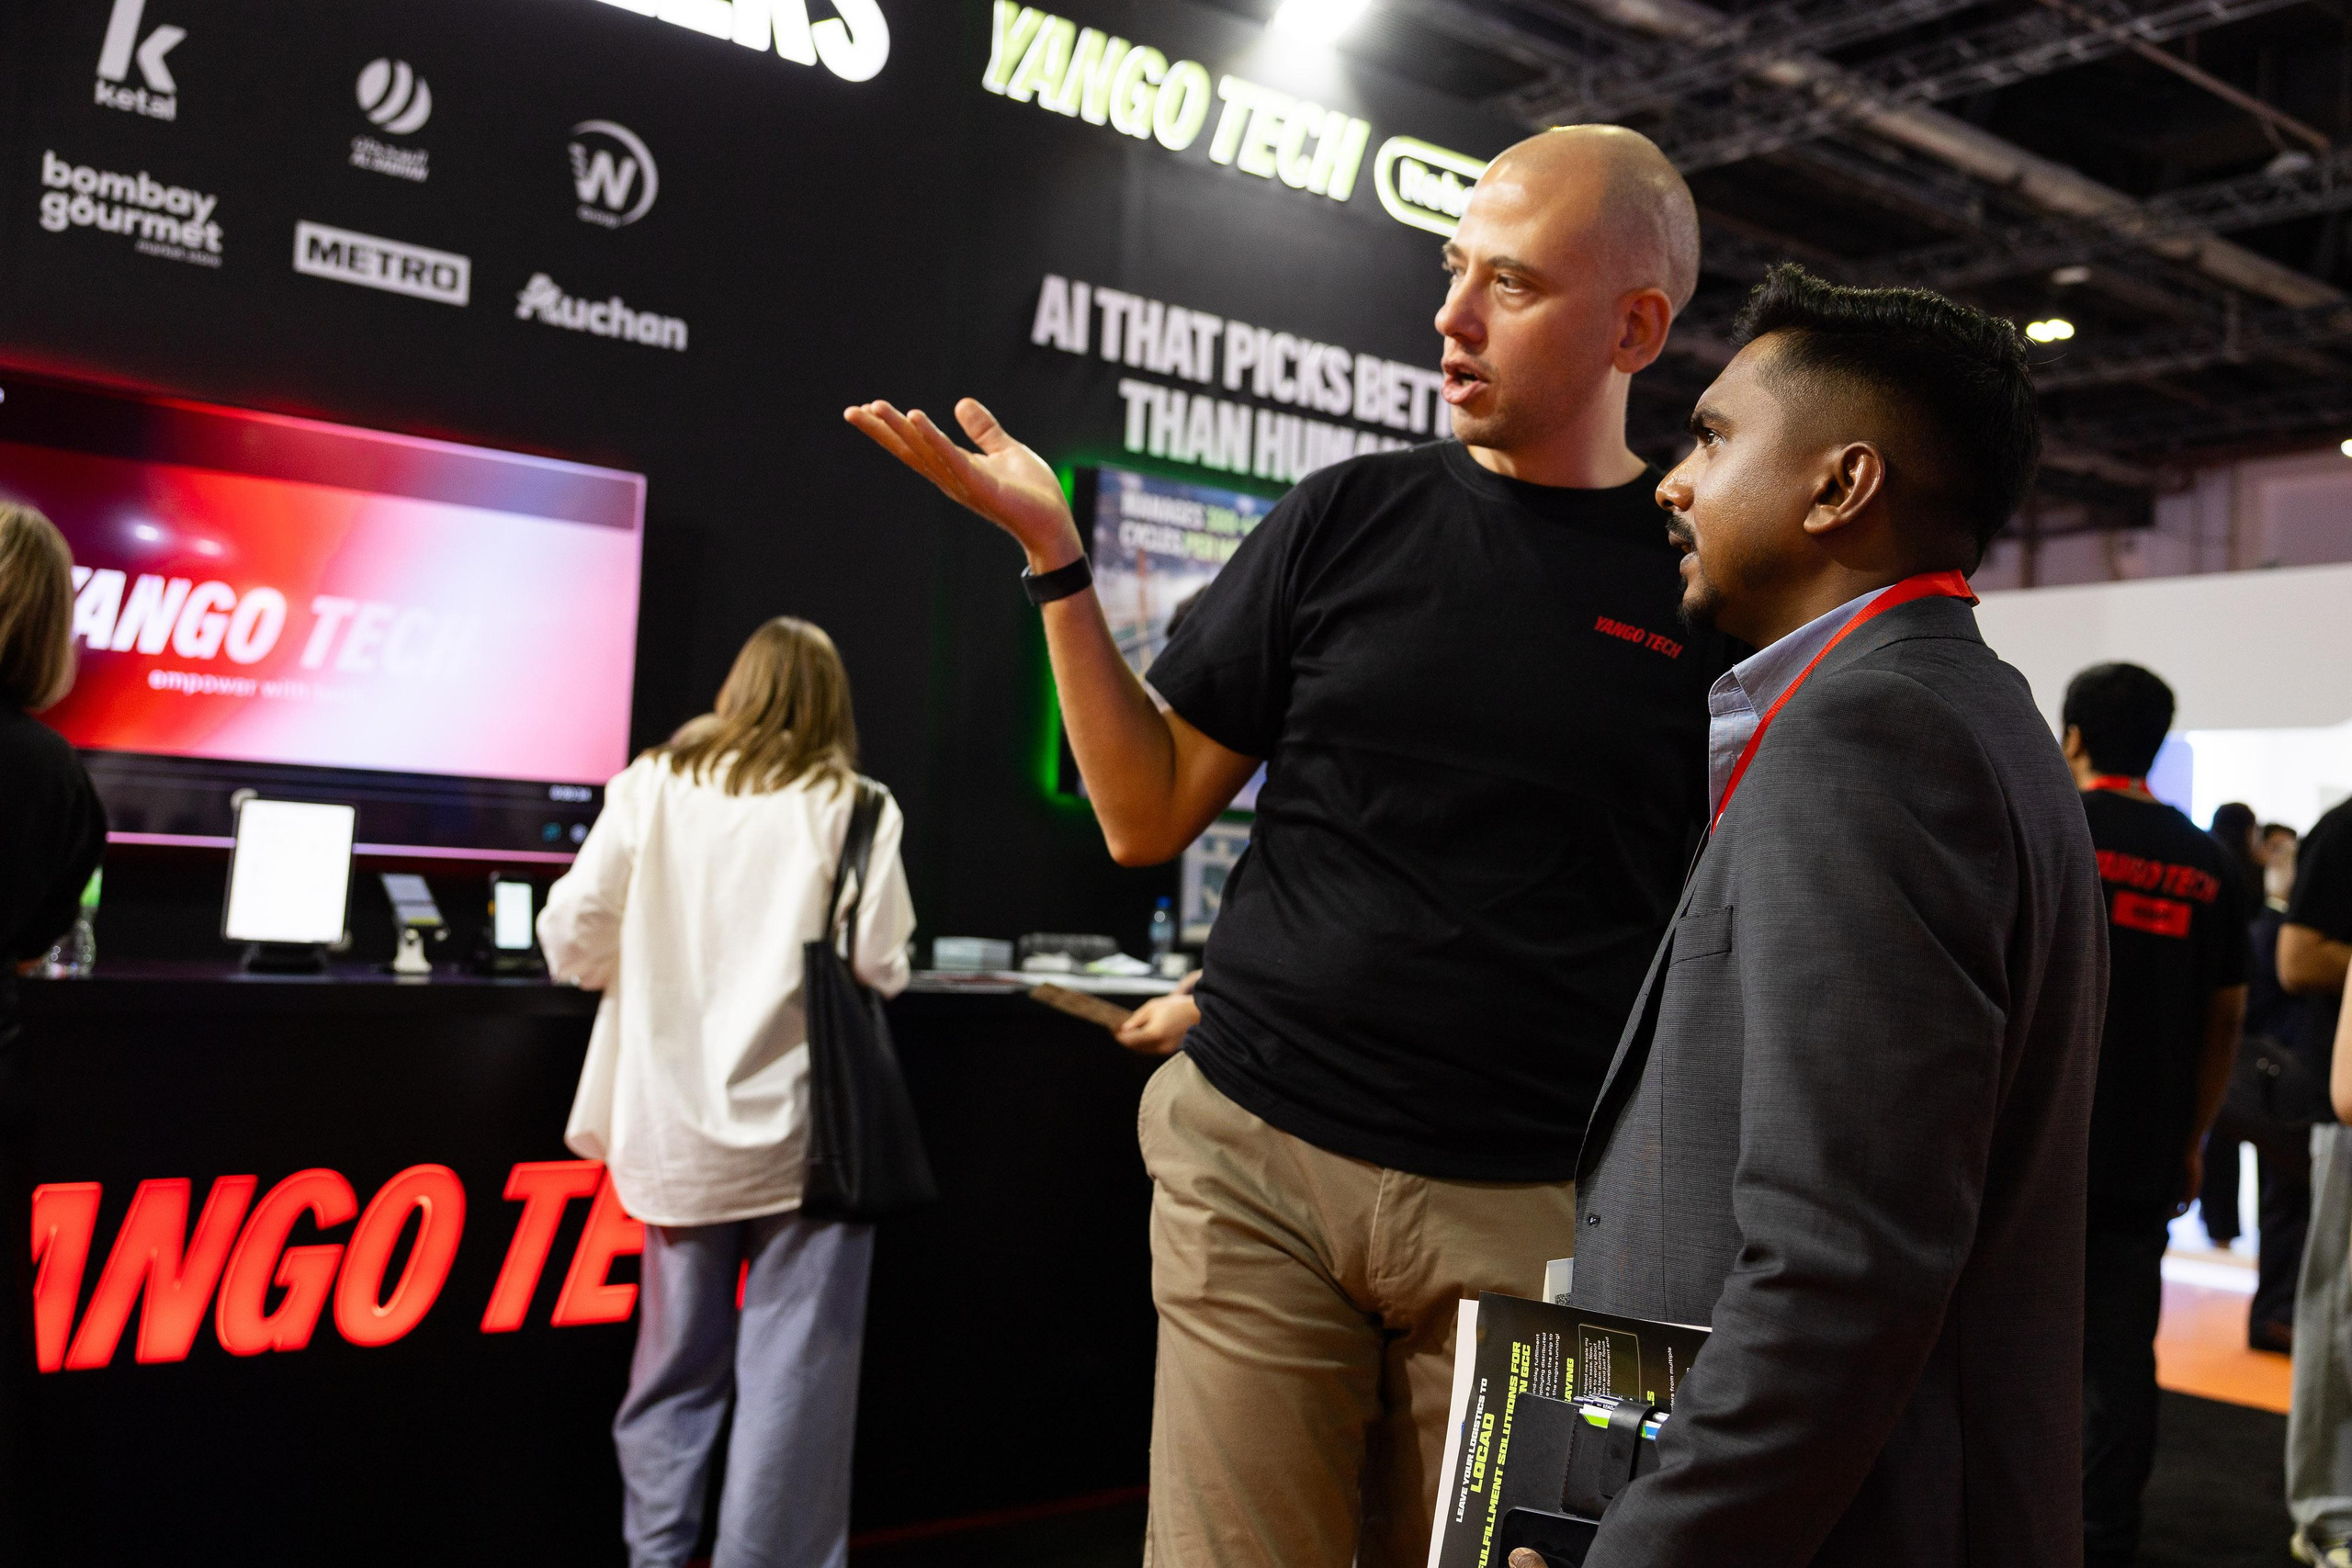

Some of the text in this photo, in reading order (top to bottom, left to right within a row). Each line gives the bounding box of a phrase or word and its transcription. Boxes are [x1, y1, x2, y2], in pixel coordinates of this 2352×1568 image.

[94, 78, 177, 121] ketal
[982, 0, 1212, 151] YANGO
[1208, 73, 1371, 202] TECH
[40, 190, 224, 254] gourmet
[41, 149, 218, 225] bombay
[307, 236, 459, 293] METRO
[516, 273, 689, 351] Auchan
[1030, 275, 1452, 438] AI THAT PICKS BETT
[1118, 378, 1253, 476] THAN
[1594, 615, 1683, 660] YANGO TECH
[148, 670, 258, 697] empower
[479, 1159, 647, 1335] TE
[1498, 1375, 1518, 1465] SOLUTIONS
[1511, 1342, 1521, 1373] FOR
[1519, 1345, 1530, 1393] N GCC
[1565, 1358, 1574, 1402] AYING
[1456, 1378, 1487, 1522] LEAVE YOUR LOGISTICS TO
[1470, 1413, 1495, 1493] LOCAD
